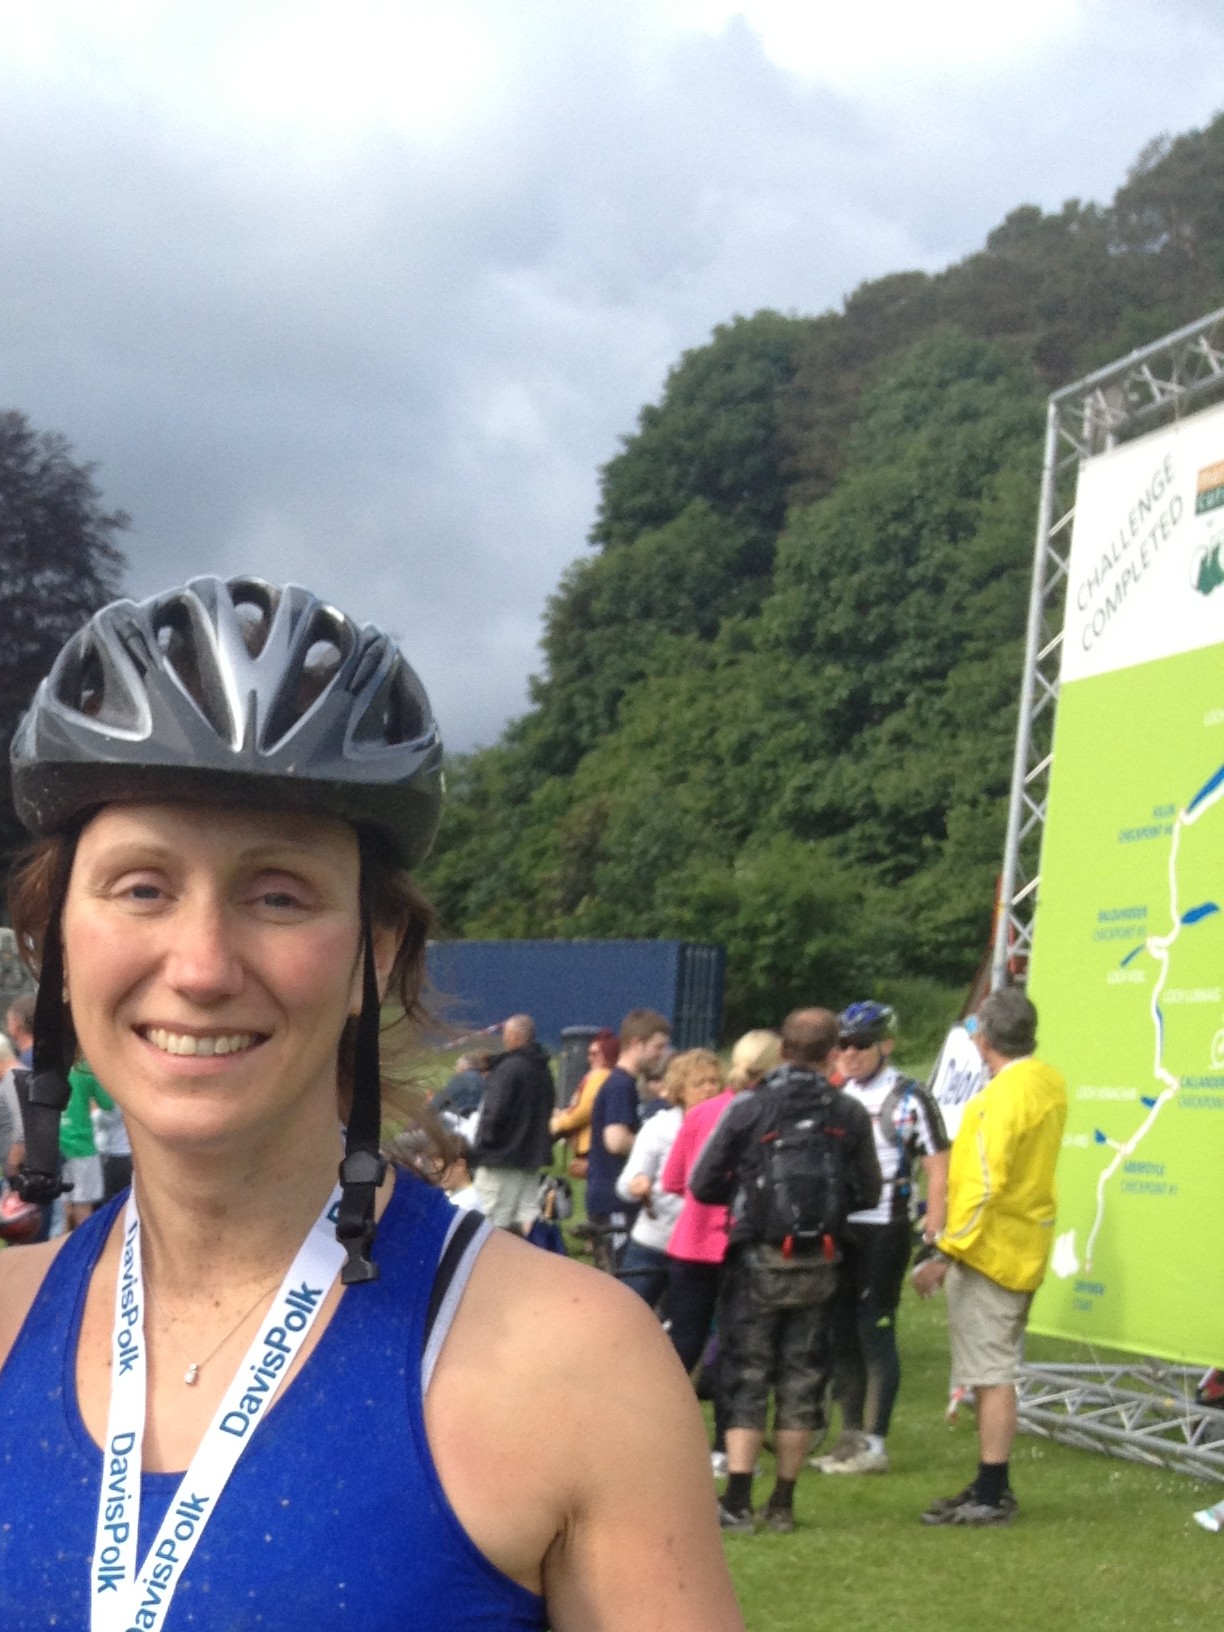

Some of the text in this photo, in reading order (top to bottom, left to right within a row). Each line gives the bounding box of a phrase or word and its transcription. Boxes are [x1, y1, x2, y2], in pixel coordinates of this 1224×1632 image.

[1077, 453, 1175, 612] CHALLENGE
[1081, 493, 1184, 652] COMPLETED
[219, 1280, 324, 1440] DavisPolk
[97, 1432, 136, 1594] DavisPolk
